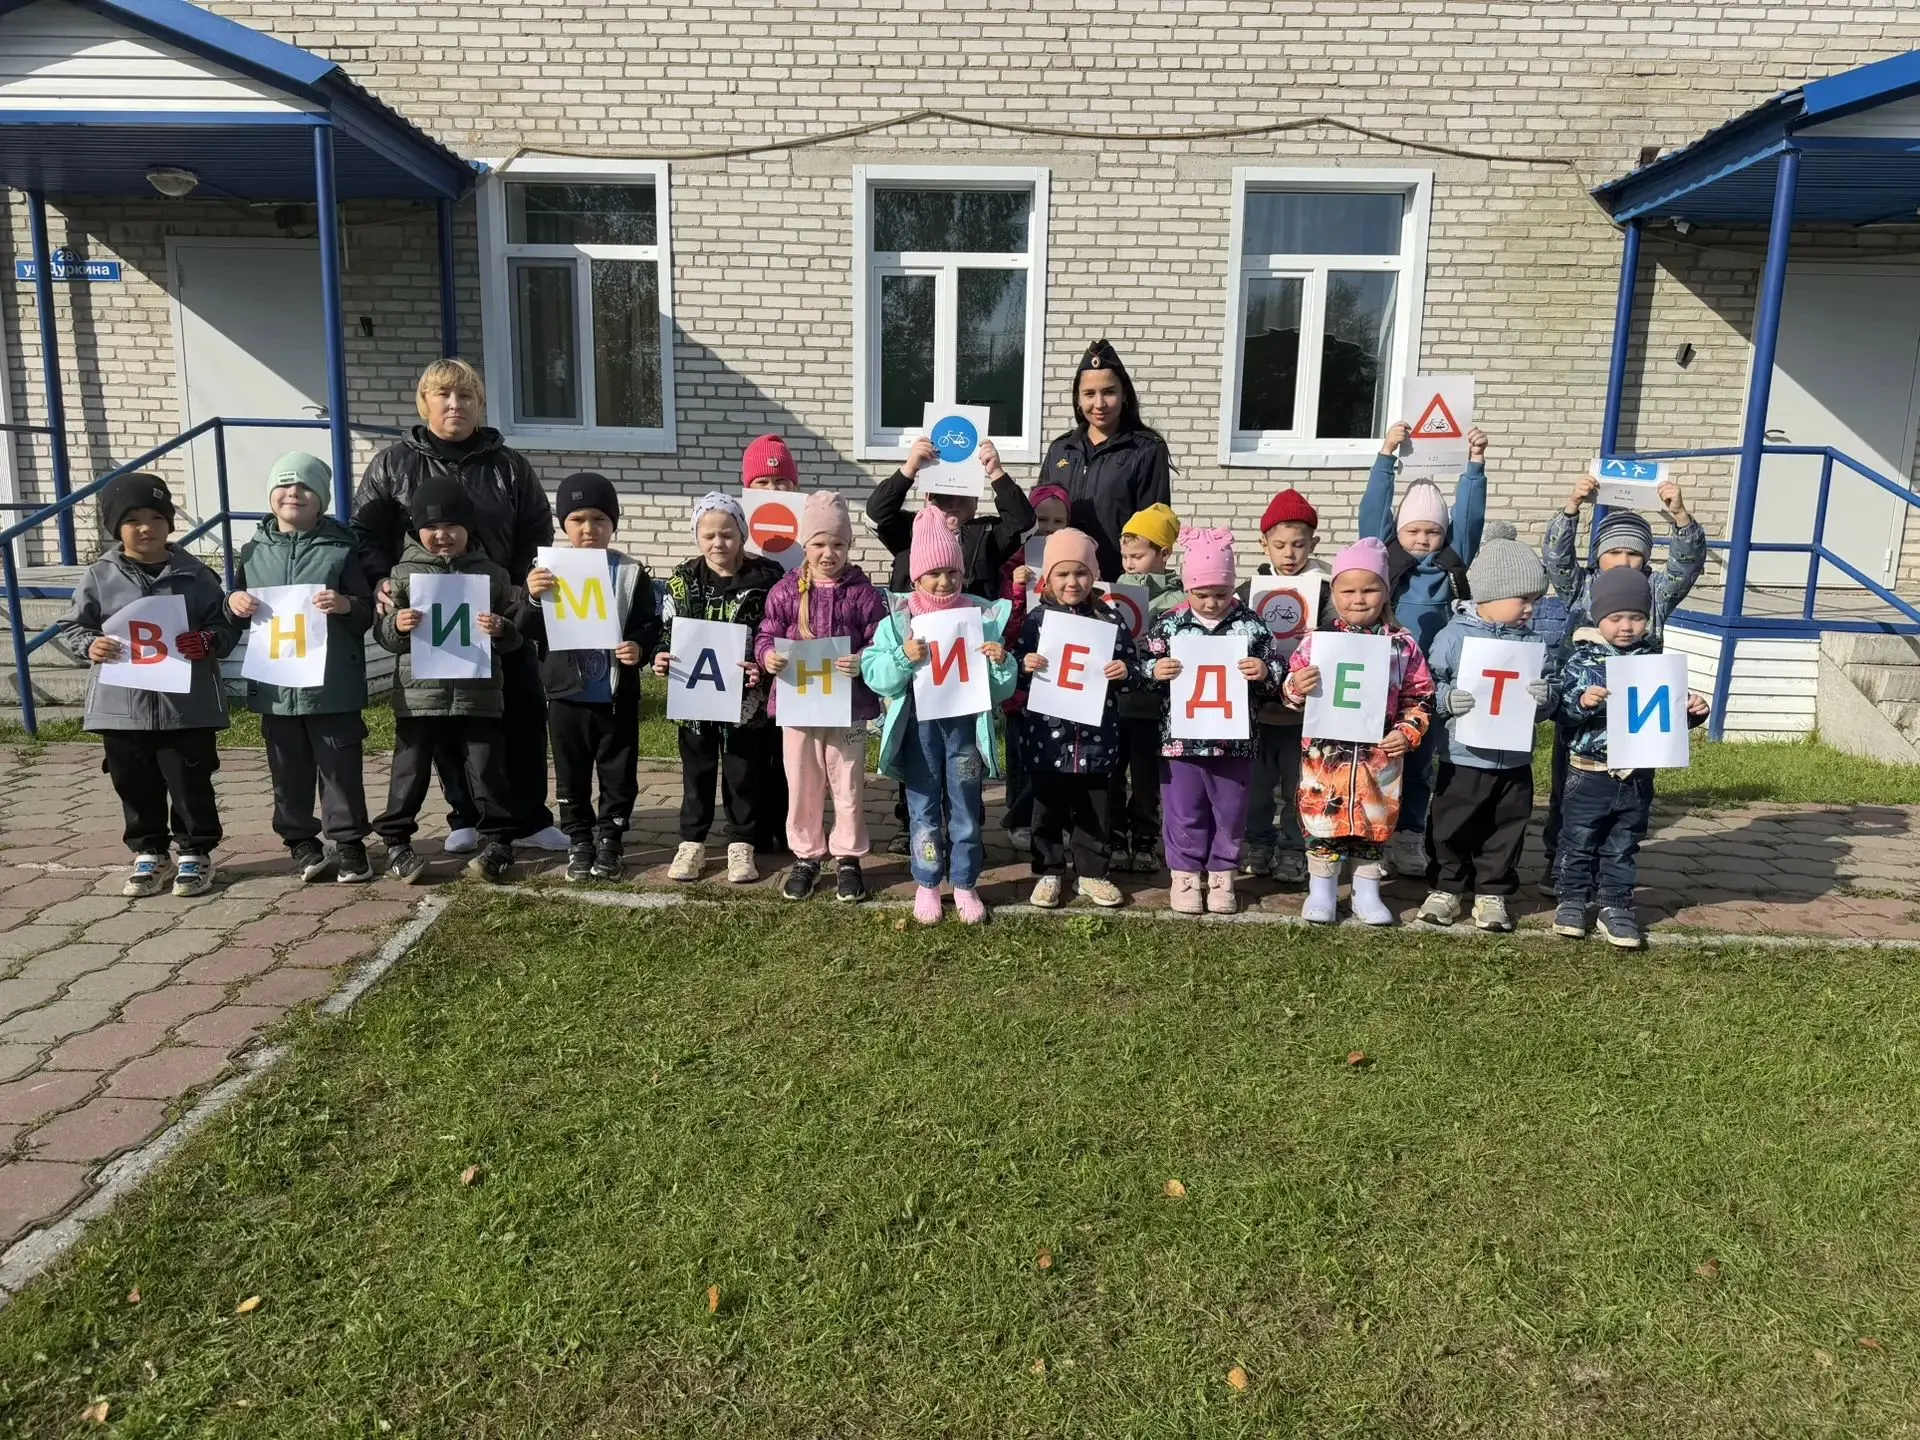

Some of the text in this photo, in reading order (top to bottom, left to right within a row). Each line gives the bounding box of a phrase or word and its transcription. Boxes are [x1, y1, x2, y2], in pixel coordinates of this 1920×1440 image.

[51, 262, 110, 276] Дуркина
[57, 250, 73, 262] 28
[551, 576, 607, 620] М
[130, 621, 168, 664] В
[269, 614, 306, 659] Н
[432, 603, 471, 647] И
[685, 648, 725, 691] А
[796, 658, 833, 696] Н
[929, 637, 969, 685] И
[1057, 643, 1091, 691] Е
[1185, 665, 1232, 719] Д
[1333, 662, 1364, 709] Е
[1482, 669, 1519, 716] Т
[1627, 685, 1671, 734] И
